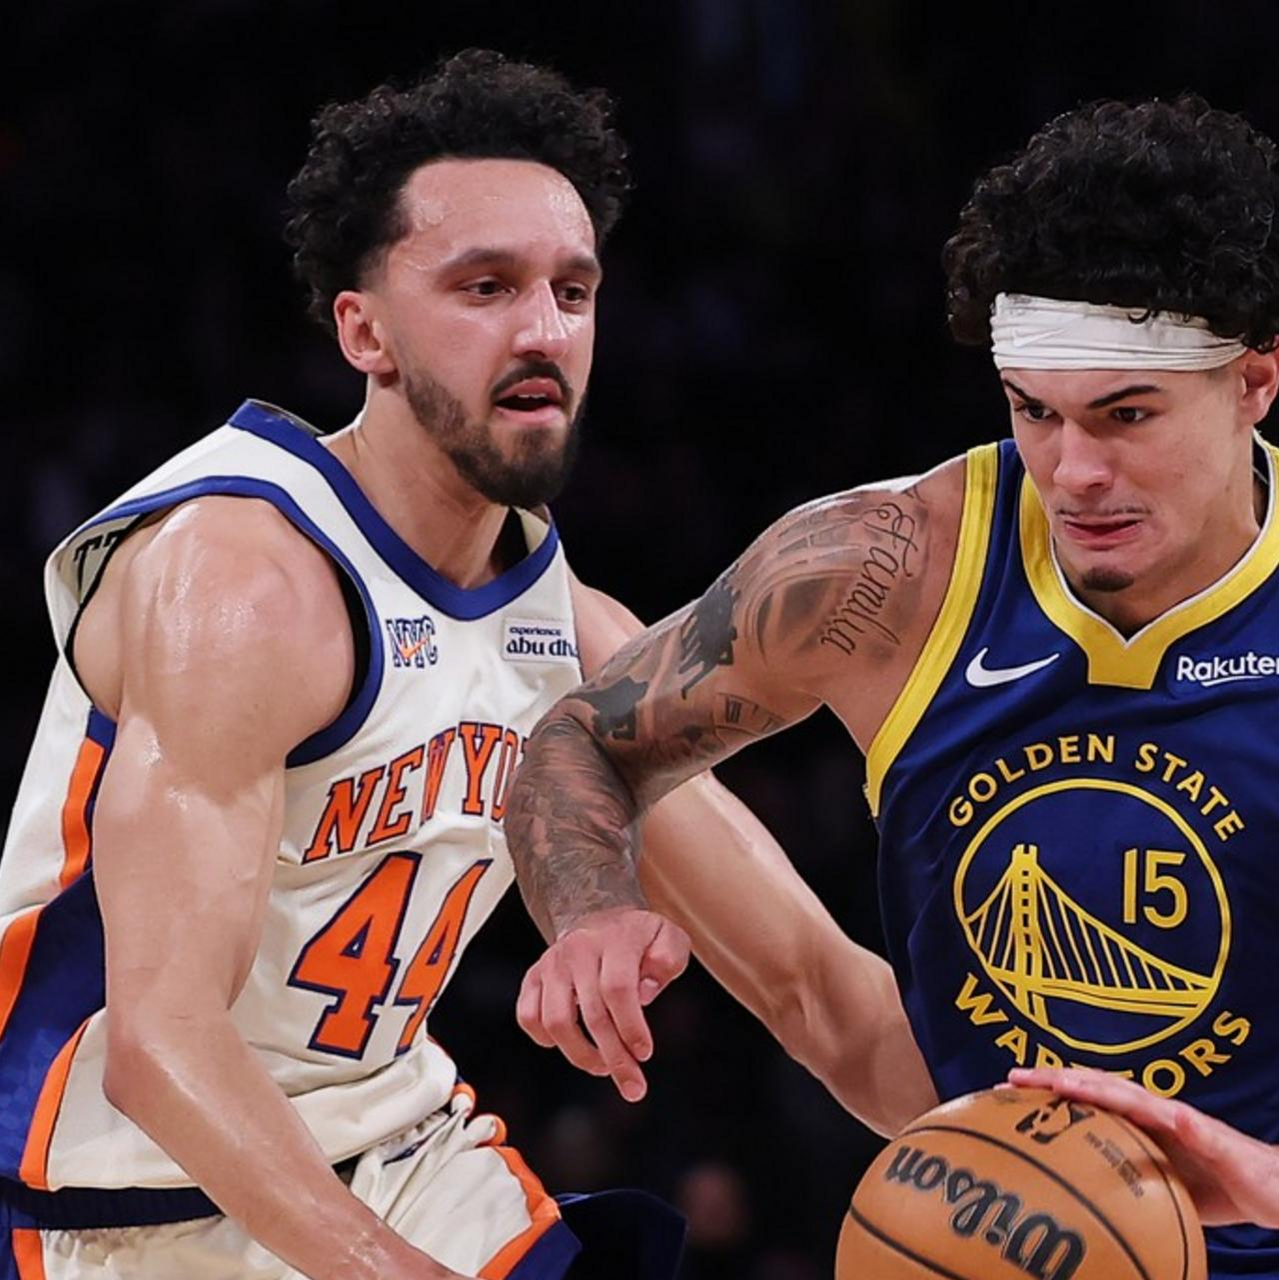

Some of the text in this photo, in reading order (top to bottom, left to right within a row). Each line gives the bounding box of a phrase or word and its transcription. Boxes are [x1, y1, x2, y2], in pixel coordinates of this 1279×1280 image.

[386, 615, 438, 668] NYC
[506, 637, 545, 655] abu
[301, 721, 526, 864] NEW YO
[949, 734, 1245, 841] GOLDEN STATE
[1124, 848, 1188, 928] 15
[287, 850, 494, 1060] 44
[955, 972, 1251, 1098] WARORS
